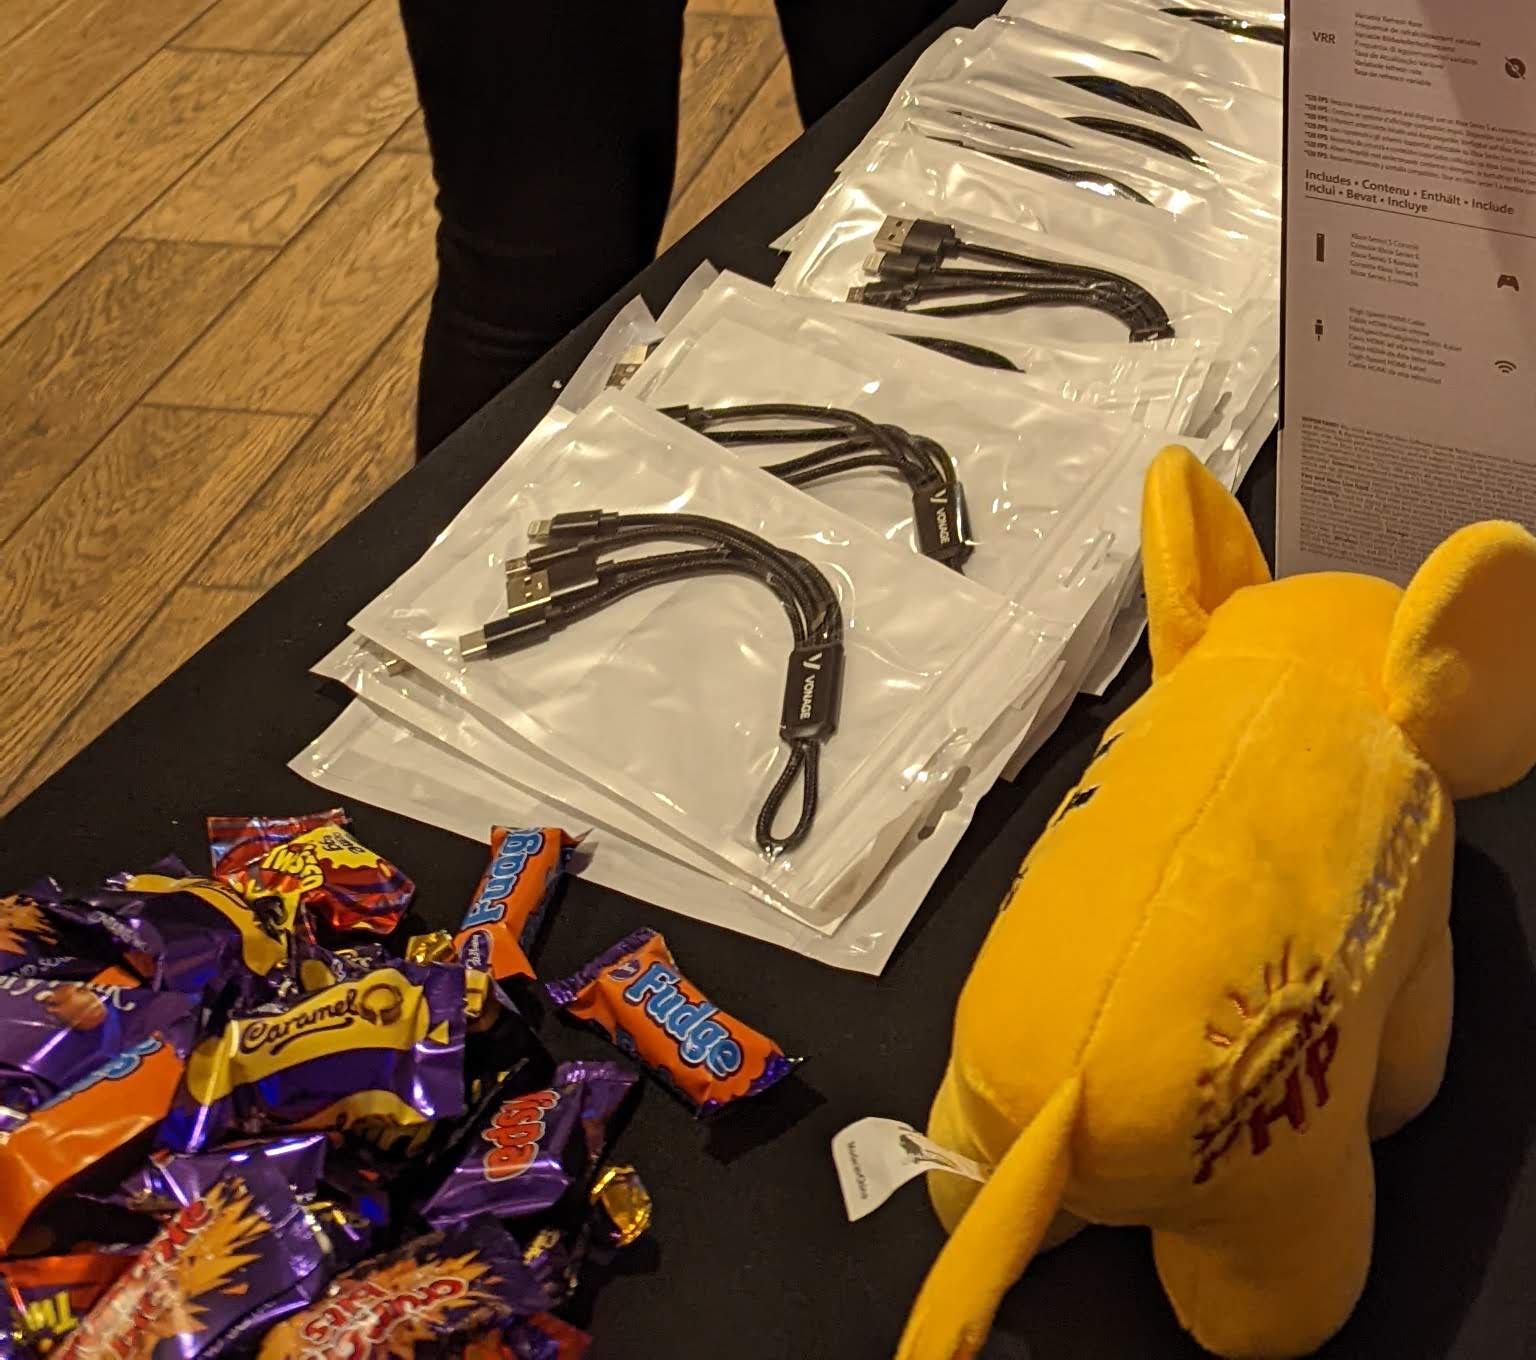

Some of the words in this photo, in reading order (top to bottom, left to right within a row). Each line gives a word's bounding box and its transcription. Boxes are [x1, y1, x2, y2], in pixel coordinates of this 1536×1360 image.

[1311, 31, 1336, 44] VRR
[1304, 169, 1352, 186] Includes
[1361, 179, 1410, 196] Contenu
[1471, 197, 1514, 214] Include
[1304, 181, 1336, 196] Inclui
[1345, 188, 1377, 203] Bevat
[1386, 196, 1429, 213] Incluye
[932, 506, 953, 545] VONAGE
[798, 673, 815, 720] VONAGE
[460, 827, 544, 930] Fudg
[239, 987, 358, 1055] Caramel
[623, 960, 743, 1079] Fudge
